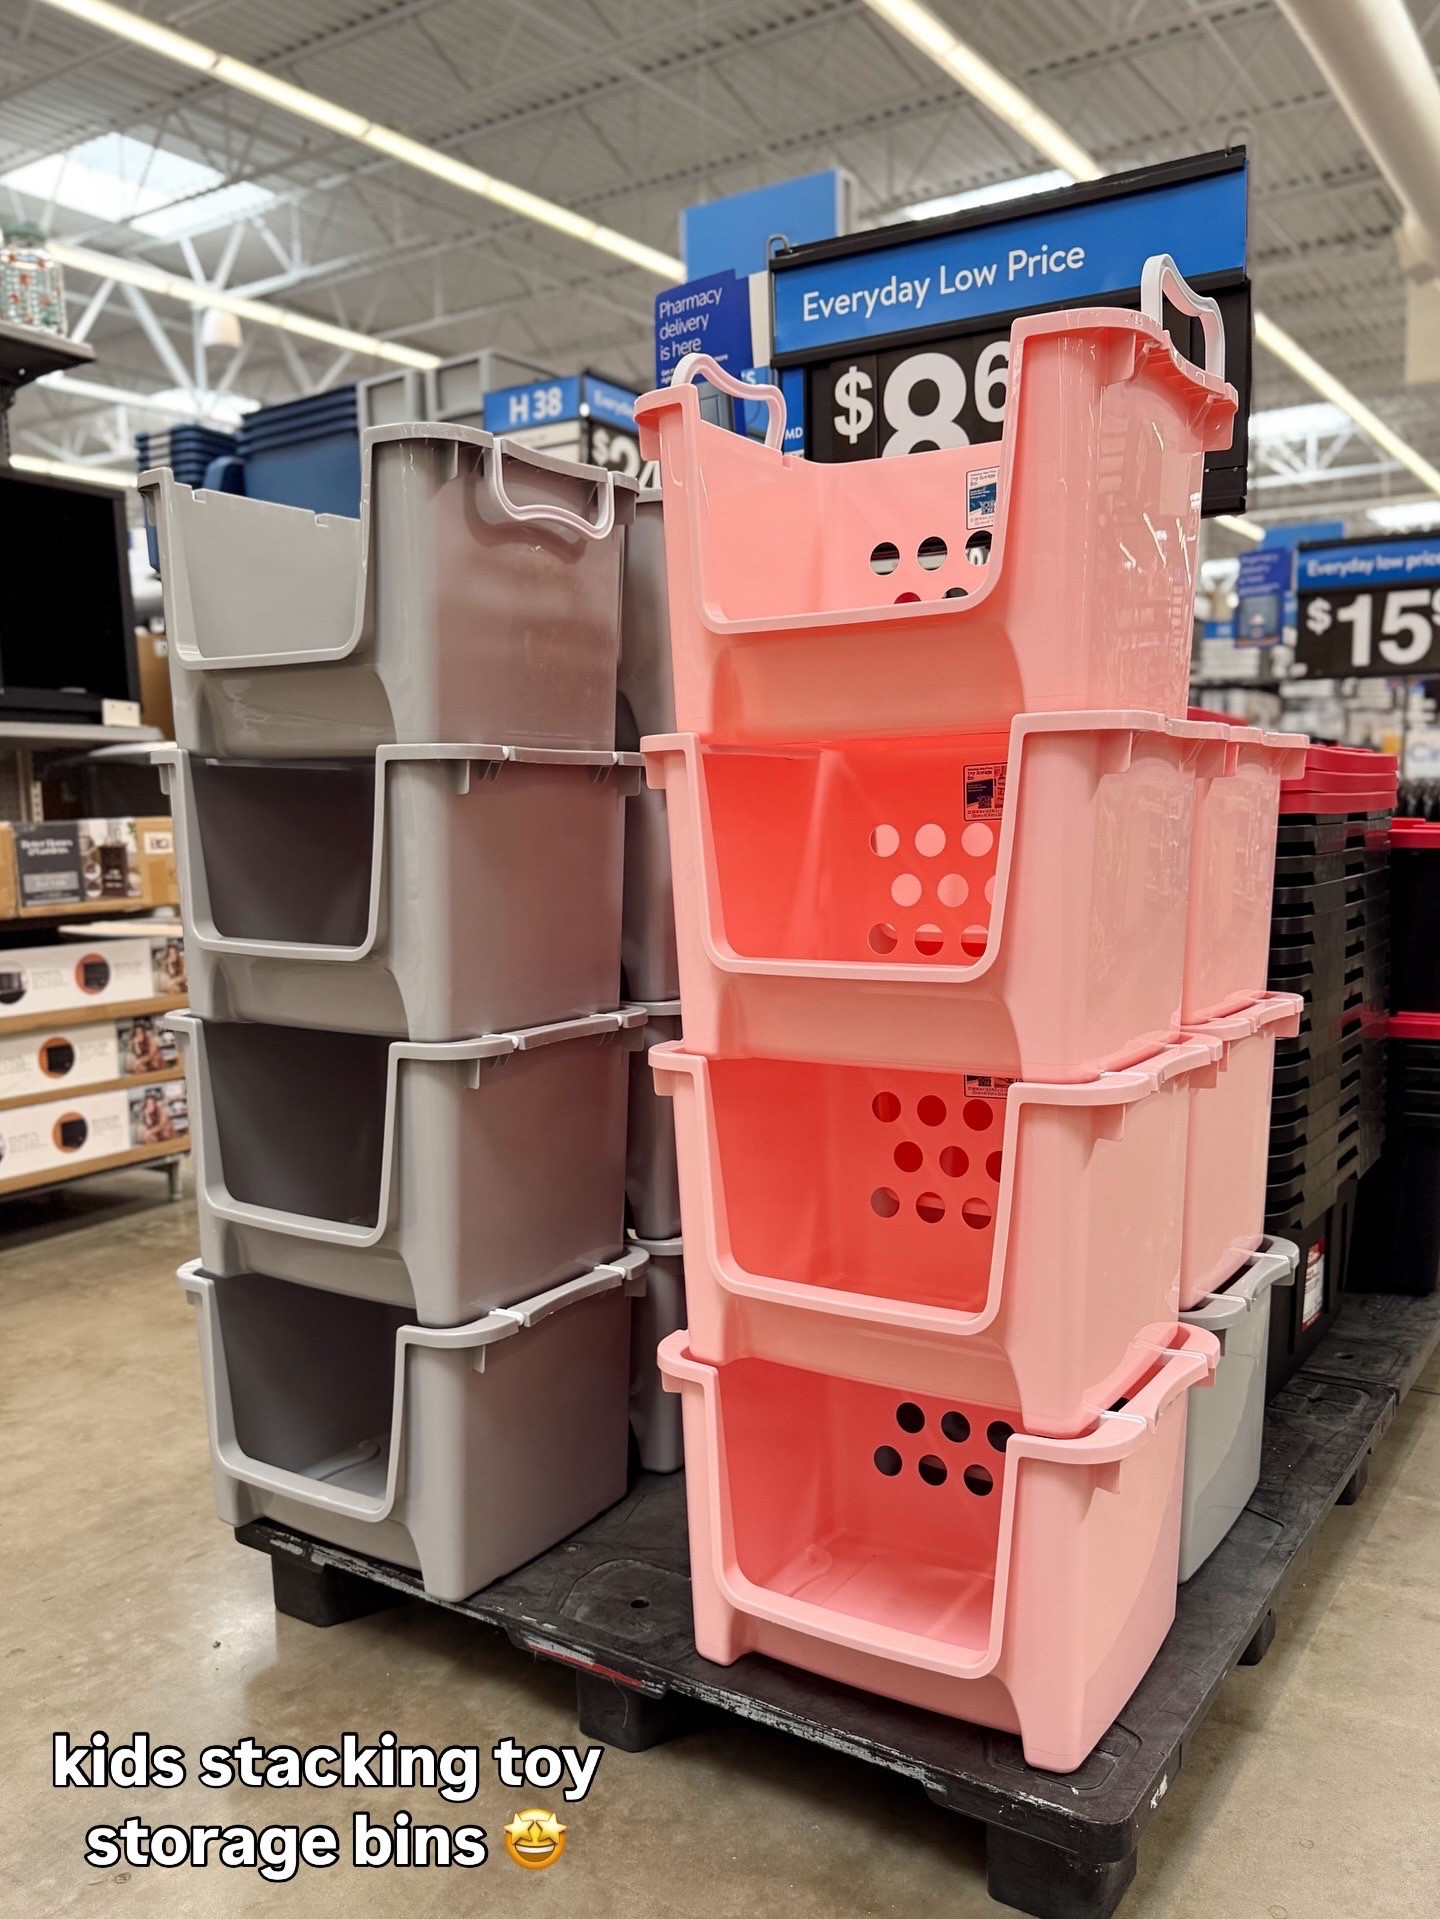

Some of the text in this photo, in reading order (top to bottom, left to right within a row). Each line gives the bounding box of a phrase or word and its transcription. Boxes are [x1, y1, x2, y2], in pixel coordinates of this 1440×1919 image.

[803, 244, 1086, 322] Everyday Low Price
[659, 287, 723, 319] Pharmacy
[659, 313, 710, 340] delivery
[660, 337, 702, 361] is here
[509, 386, 563, 425] H 38
[1307, 558, 1375, 578] Everyday
